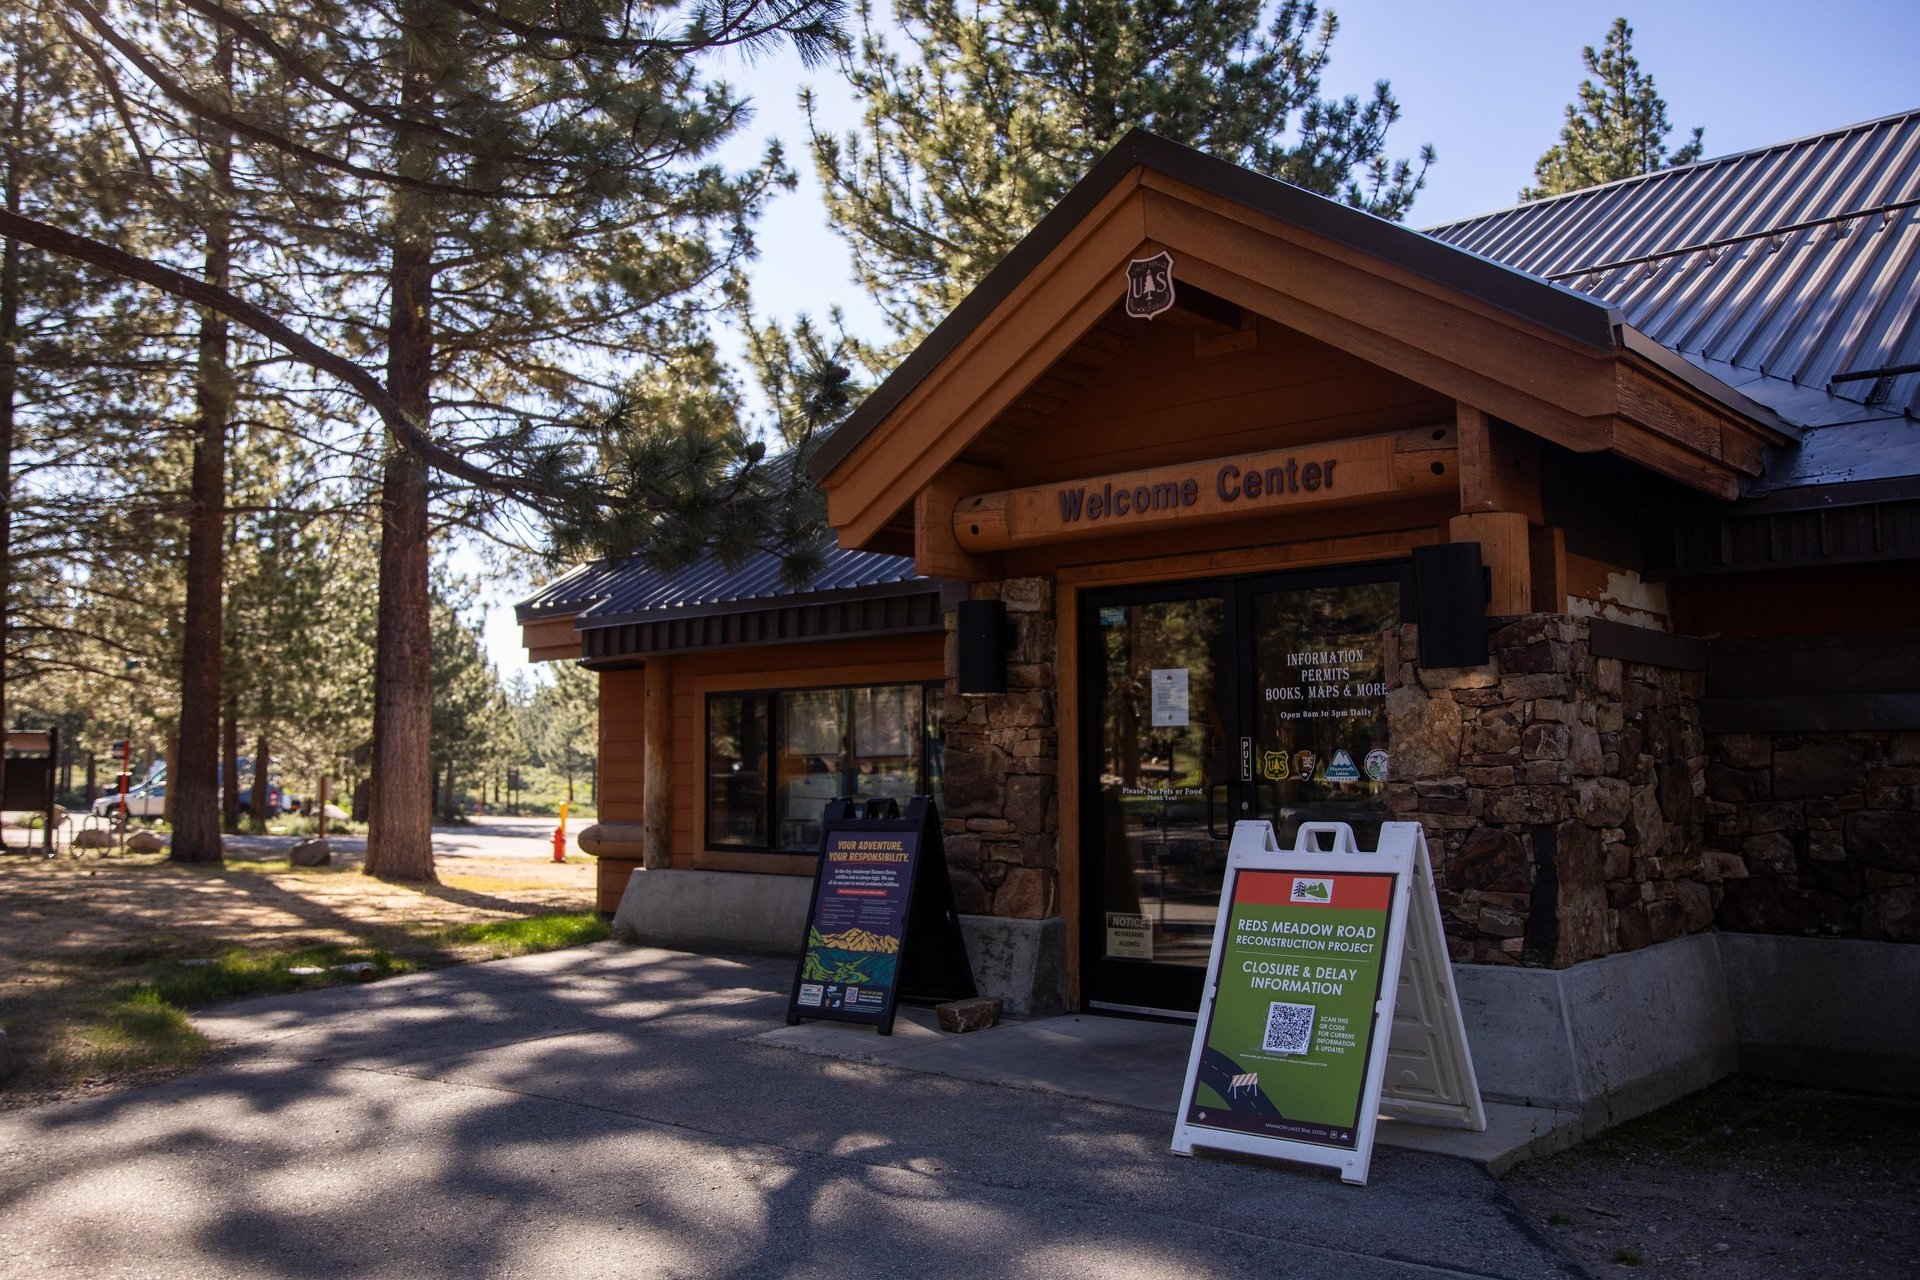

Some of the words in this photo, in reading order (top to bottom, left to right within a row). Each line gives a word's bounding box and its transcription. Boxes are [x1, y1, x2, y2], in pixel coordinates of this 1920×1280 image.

[1058, 478, 1198, 522] Welcome
[1217, 457, 1336, 502] Center
[1287, 649, 1364, 666] INFORMATION
[1301, 667, 1350, 682] PERMITS
[1265, 686, 1304, 700] BOOKS,
[1308, 684, 1340, 698] MAPS
[1343, 684, 1352, 697] &
[1356, 682, 1388, 696] MORE
[1280, 711, 1300, 720] Open
[1302, 710, 1318, 718] 8am
[1331, 709, 1348, 719] 5pm
[1350, 708, 1372, 717] Daily
[1122, 787, 1146, 795] Please,
[838, 841, 857, 850] YOUR
[858, 841, 903, 852] ADVENTURE,
[828, 852, 848, 861] YOUR
[848, 852, 909, 862] RESPONSIBILITY.
[1112, 916, 1146, 928] NOTICE
[1238, 919, 1268, 932] REDS
[1271, 921, 1333, 936] MEADOW
[1336, 926, 1376, 938] ROAD
[1236, 935, 1325, 950] RECONSTRUCTION
[1328, 942, 1374, 953] PROJECT
[1242, 961, 1300, 977] CLOSURE
[1302, 966, 1311, 978] &
[1316, 966, 1358, 981] DELAY
[1251, 976, 1343, 996] INFORMATION
[1316, 1038, 1355, 1047] INFORMATION
[1320, 1046, 1345, 1054] UPDATES
